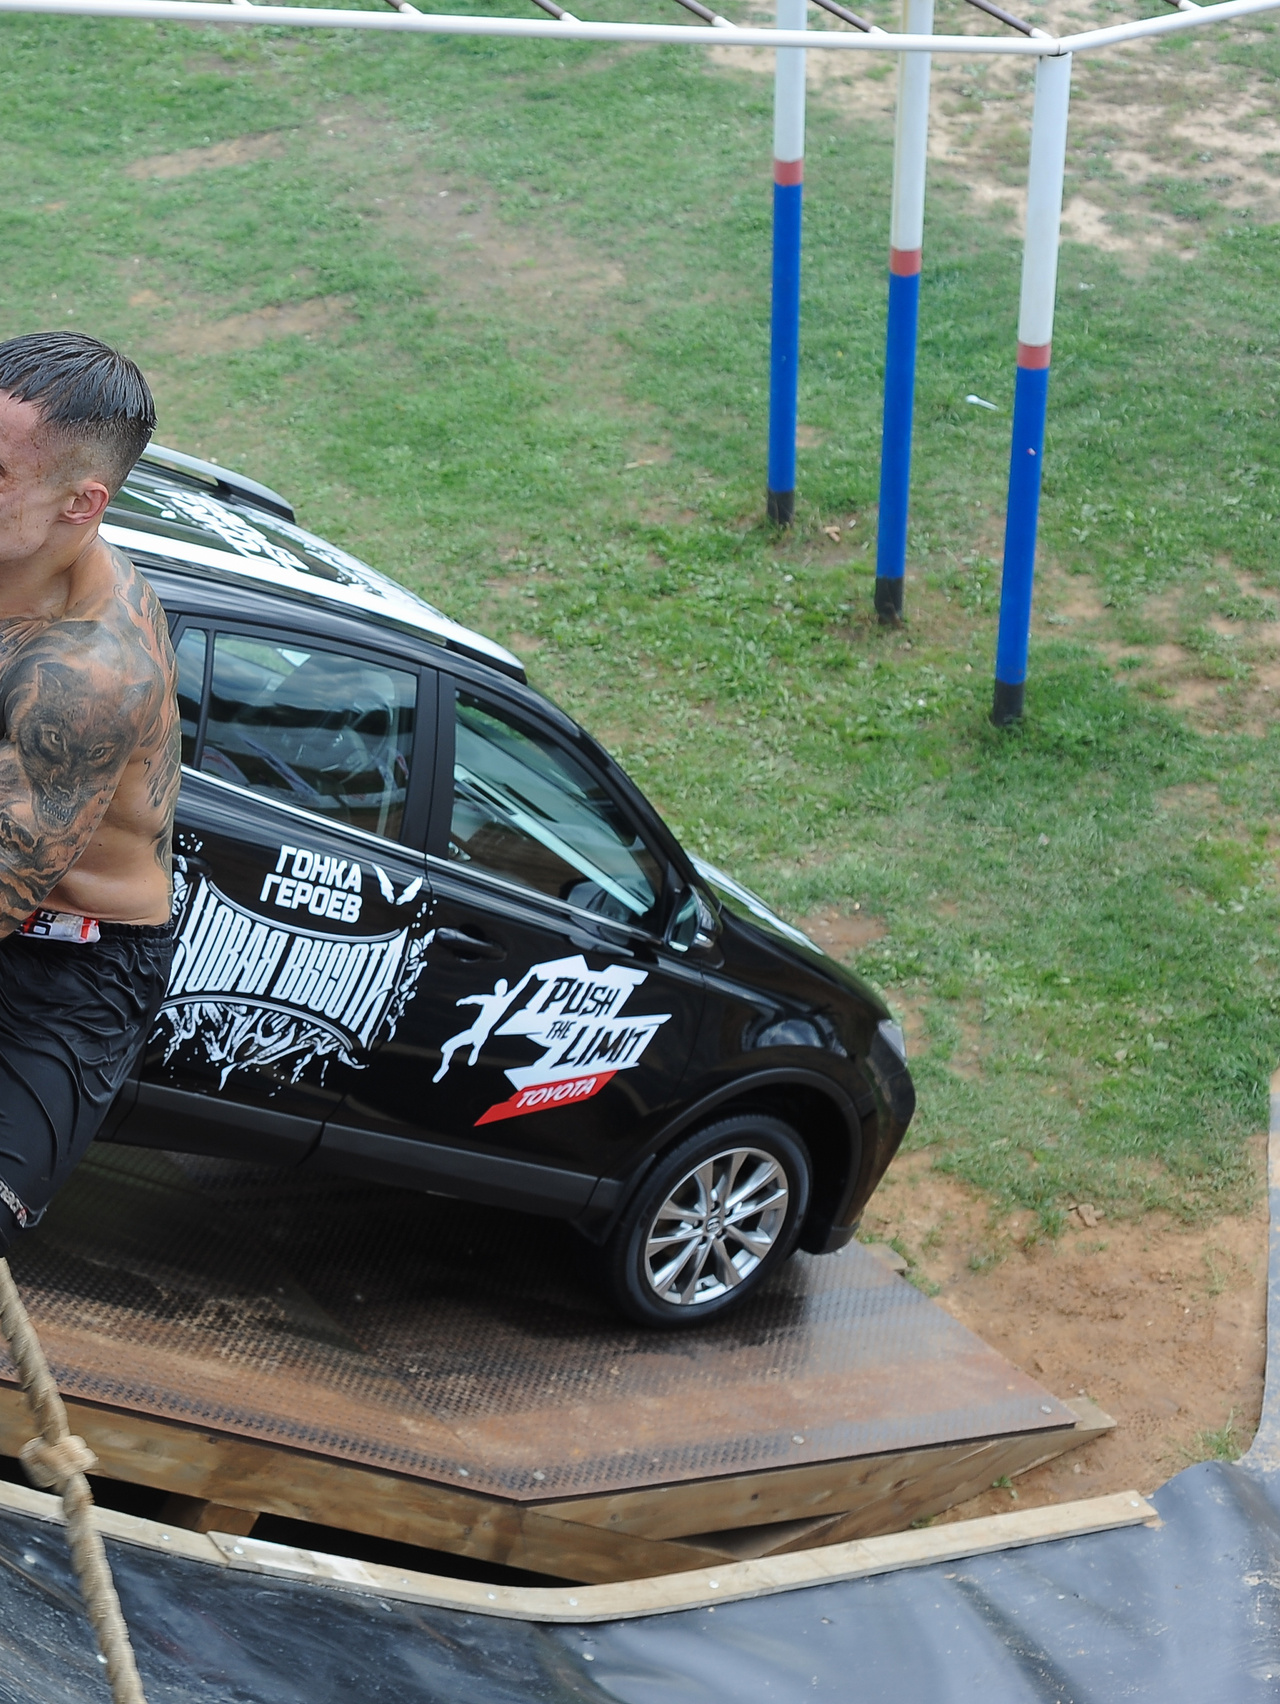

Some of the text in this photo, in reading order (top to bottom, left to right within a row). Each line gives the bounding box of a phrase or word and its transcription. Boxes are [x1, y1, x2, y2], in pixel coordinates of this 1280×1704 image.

[274, 844, 363, 893] ГОНКА
[259, 873, 363, 924] ГЕРОЕВ
[537, 977, 622, 1018] PUSH
[546, 1020, 576, 1040] THE
[549, 1025, 649, 1069] LIMIT
[516, 1077, 597, 1109] TOYOTA
